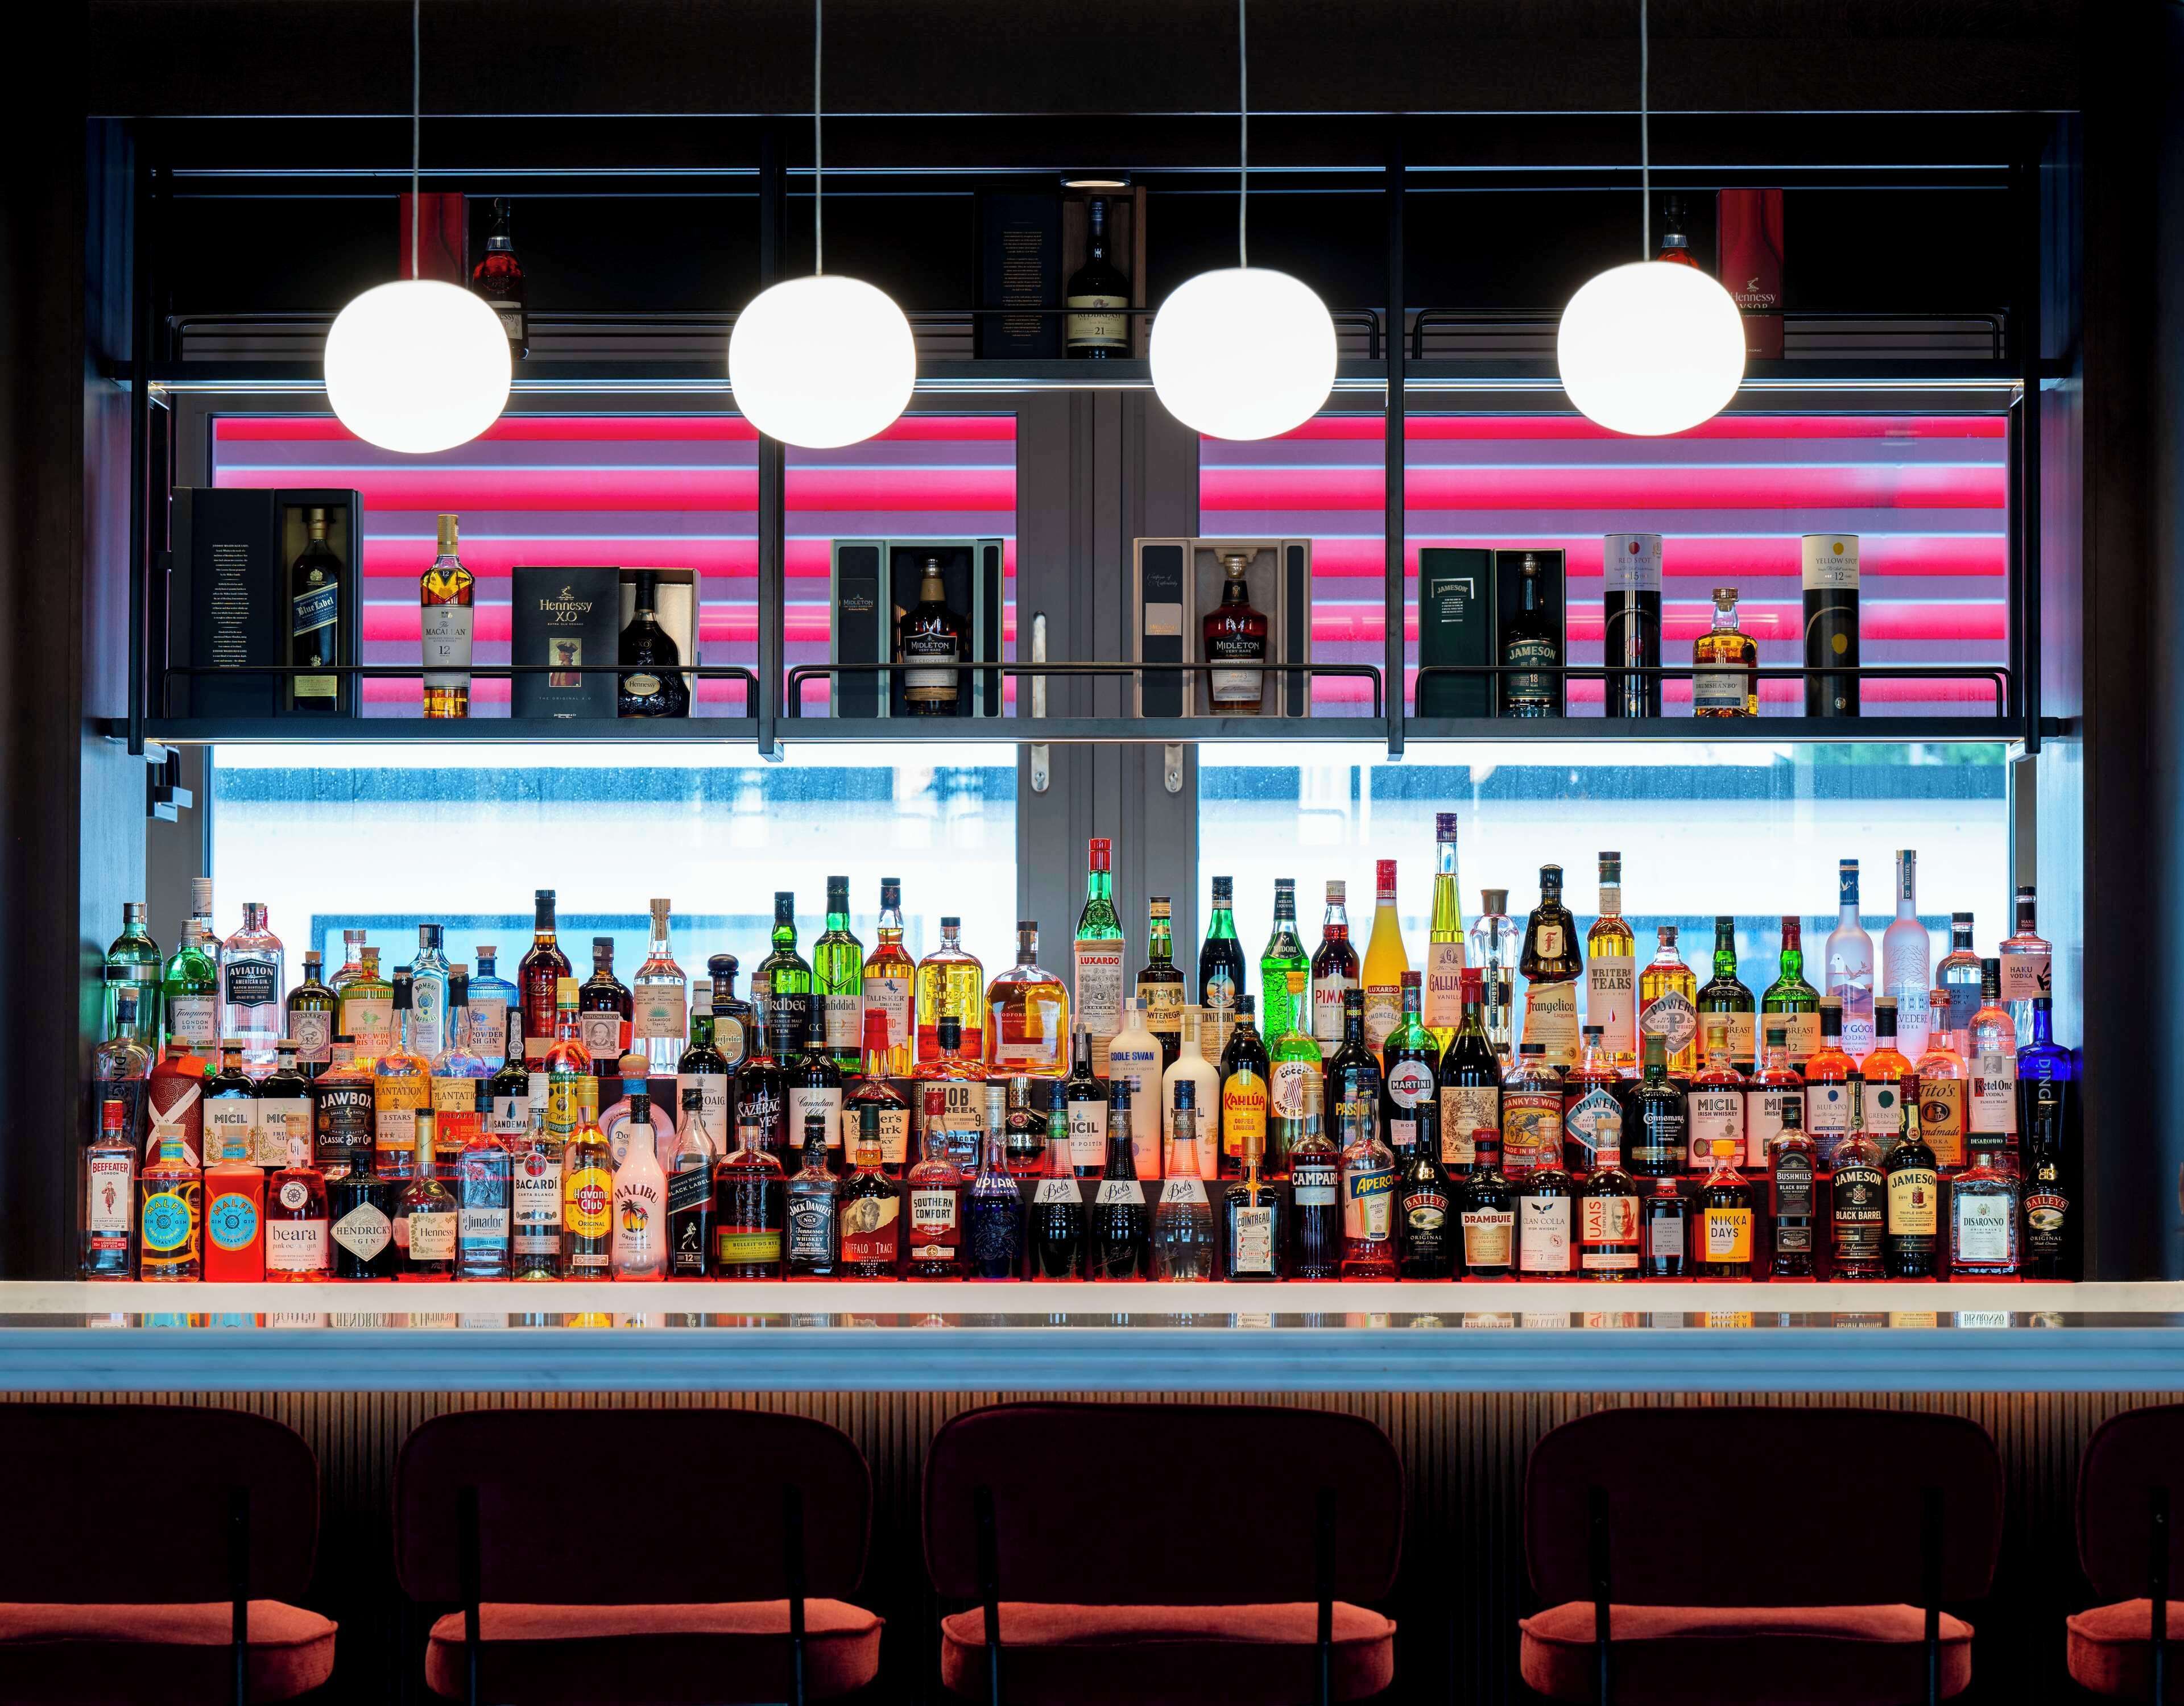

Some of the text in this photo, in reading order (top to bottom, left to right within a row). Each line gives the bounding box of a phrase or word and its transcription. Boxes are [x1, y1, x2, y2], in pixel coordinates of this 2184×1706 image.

[1437, 585, 1468, 594] JAMESON
[539, 599, 592, 613] Hennessy
[438, 645, 450, 655] 12
[1509, 646, 1556, 660] JAMESON
[1530, 674, 1538, 682] 18
[229, 967, 274, 976] AVIATION
[415, 983, 437, 992] BOMBAY
[1592, 978, 1631, 989] TEARS
[1527, 994, 1574, 1015] Frangelico
[1651, 998, 1695, 1016] POWERS
[176, 1008, 213, 1018] Tanqueray
[1366, 1012, 1401, 1022] LIMONCELLO
[1787, 1043, 1798, 1051] 12
[1132, 1052, 1154, 1061] SWAN
[2038, 1059, 2051, 1099] DING
[1392, 1080, 1430, 1090] MARTINI
[320, 1092, 372, 1108] JAWBOX
[797, 1096, 834, 1107] Canadian
[1224, 1092, 1266, 1111] KAHLÚA
[1577, 1097, 1621, 1114] POWERS
[1698, 1099, 1737, 1111] MICIL
[738, 1100, 781, 1117] SAZERAC
[214, 1114, 247, 1124] MICIL
[975, 1114, 981, 1127] 9
[320, 1135, 345, 1145] CLASSIC
[347, 1134, 361, 1145] DRY
[93, 1162, 128, 1174] BEEFEATER
[1292, 1172, 1337, 1186] CAMPARI
[1777, 1172, 1811, 1181] BUSHMILLS
[1835, 1171, 1881, 1187] JAMESON
[1892, 1173, 1936, 1188] JAMESON
[516, 1177, 558, 1190] BACARDÍ
[1356, 1174, 1393, 1194] APEROL
[574, 1189, 609, 1199] Havana
[614, 1185, 659, 1204] MALIBU
[147, 1199, 185, 1216] MALFY
[213, 1199, 253, 1216] MALFY
[581, 1199, 603, 1210] Club
[789, 1199, 832, 1216] JACK DANIEL'S
[913, 1198, 953, 1208] SOUTHERN
[1406, 1196, 1447, 1208] BAILEYS
[2026, 1199, 2065, 1208] BAILEYS
[916, 1209, 951, 1218] COMFORT
[1465, 1215, 1511, 1223] DRAMBUIE
[1836, 1210, 1881, 1220] BLACK BARREL
[1238, 1212, 1271, 1228] COINTREAU
[1589, 1201, 1601, 1238] UAIS
[1711, 1215, 1747, 1226] NIKKA
[272, 1225, 317, 1240] beara
[420, 1228, 454, 1237] Hennessy
[1711, 1228, 1739, 1238] DAYS
[845, 1243, 892, 1254] BUFFALO TRACE
